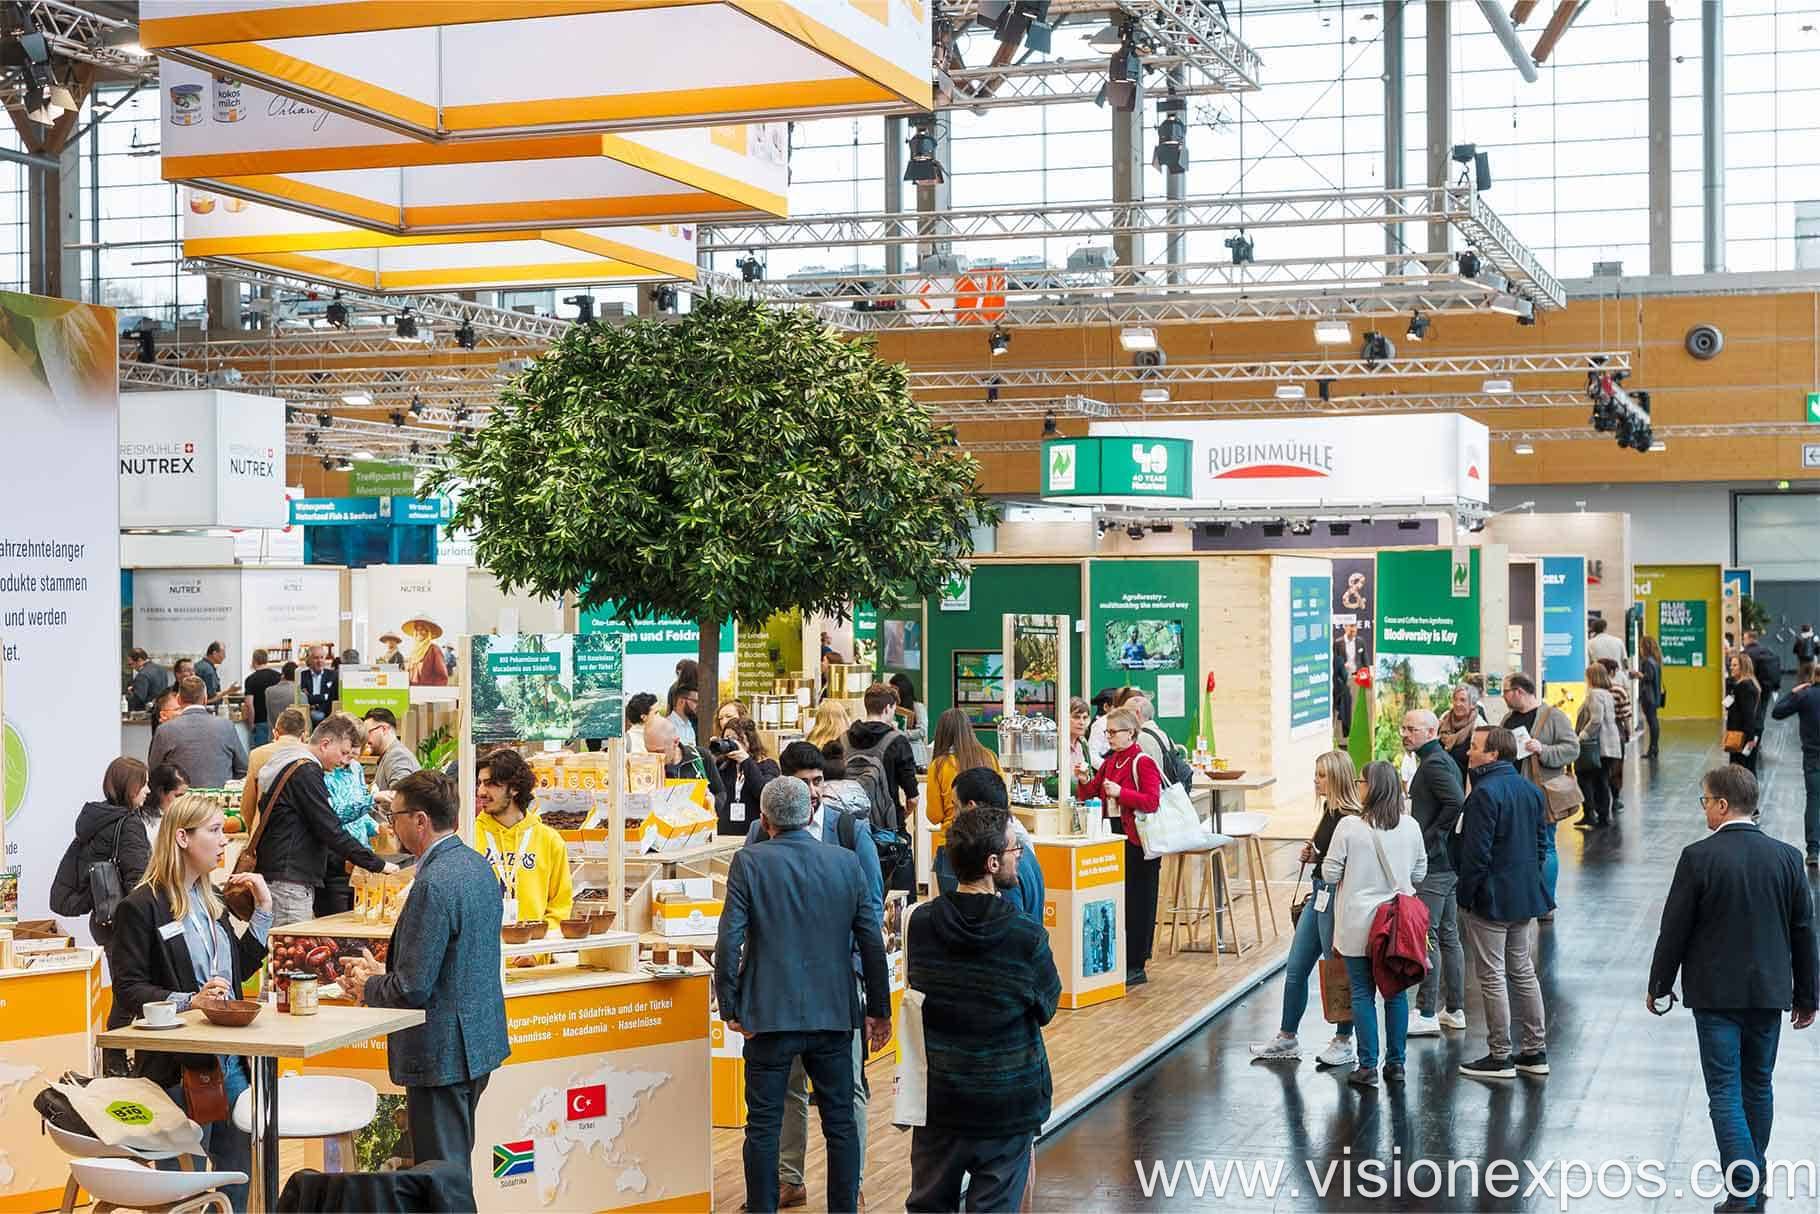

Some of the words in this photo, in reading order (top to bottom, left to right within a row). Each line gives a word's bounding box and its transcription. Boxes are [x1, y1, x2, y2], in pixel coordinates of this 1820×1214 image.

[218, 99, 240, 108] milch
[1208, 439, 1334, 474] RUBINMÜHLE
[121, 457, 194, 475] NUTREX
[231, 459, 273, 477] NUTREX
[0, 573, 37, 592] odukte
[40, 574, 87, 592] stammen
[169, 585, 201, 594] NUTREX
[400, 585, 432, 593] NUTREX
[5, 608, 25, 626] und
[28, 608, 67, 626] werden
[1661, 617, 1693, 625] PARTY
[640, 631, 664, 642] und
[1384, 628, 1432, 645] Biodiversity
[1433, 629, 1441, 642] is
[1441, 629, 1458, 645] Key
[508, 1013, 567, 1032] Agrar-Projekte
[569, 1010, 577, 1021] in
[579, 1004, 617, 1019] Südafrika
[618, 1002, 633, 1015] und
[634, 1000, 648, 1013] der
[650, 998, 673, 1010] Türkei
[563, 1022, 608, 1037] Macadamia
[619, 1016, 662, 1031] Haselnüsse
